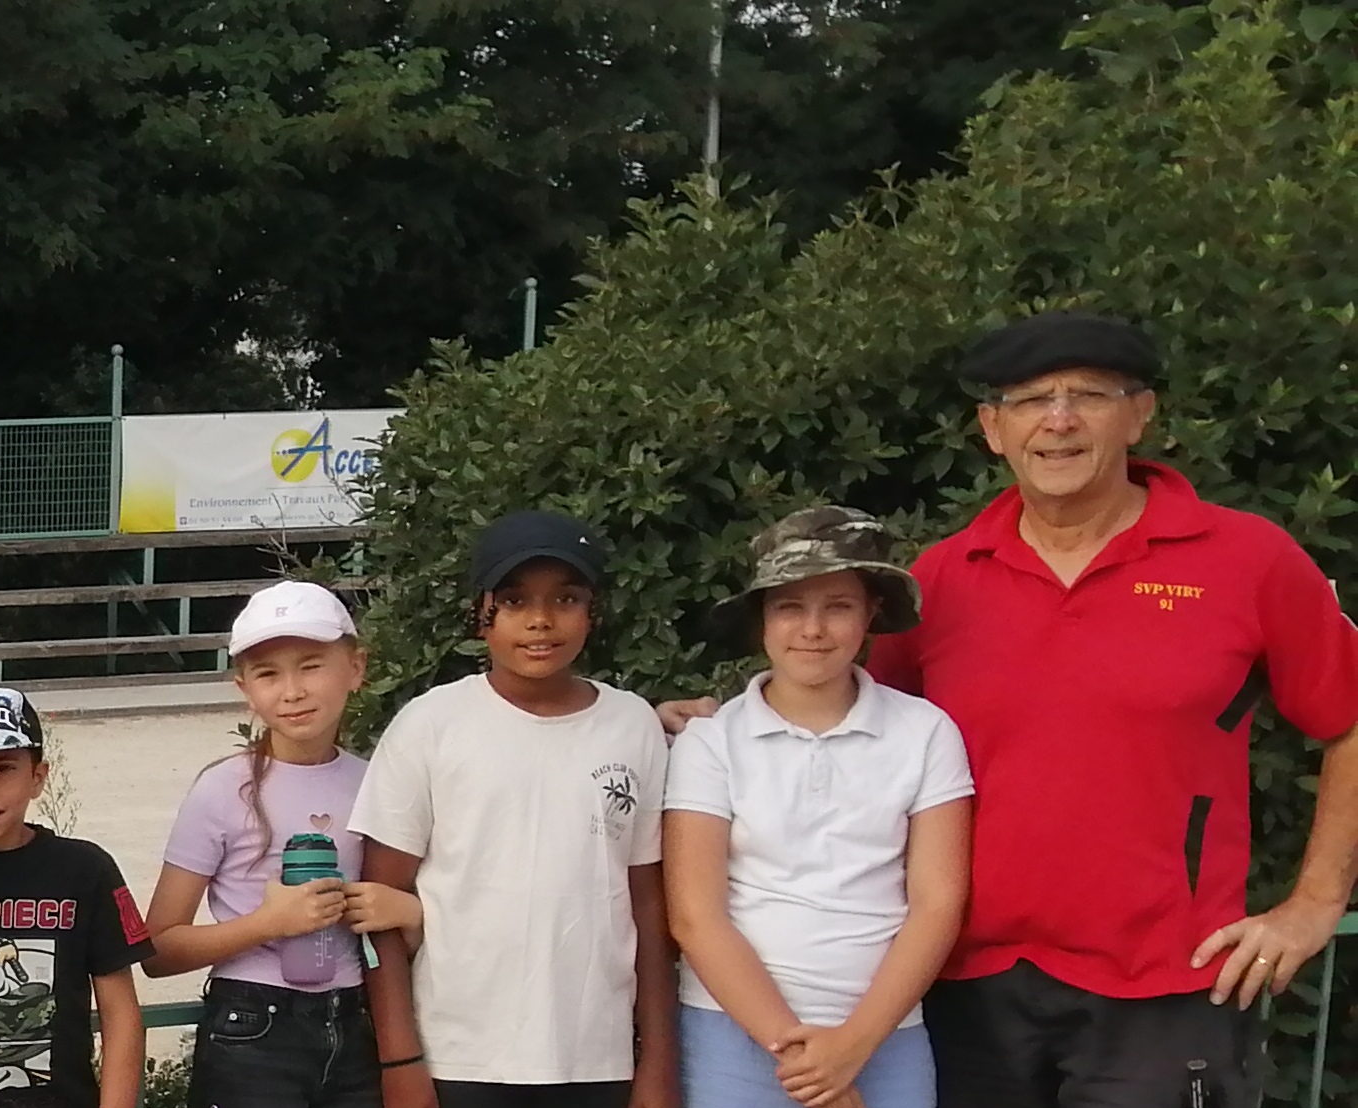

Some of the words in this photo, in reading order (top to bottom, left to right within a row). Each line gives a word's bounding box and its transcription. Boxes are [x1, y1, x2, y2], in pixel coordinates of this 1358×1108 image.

[190, 495, 272, 508] Environnement
[1134, 582, 1164, 595] SVP
[1166, 584, 1205, 599] VIRY
[1159, 598, 1173, 611] 91
